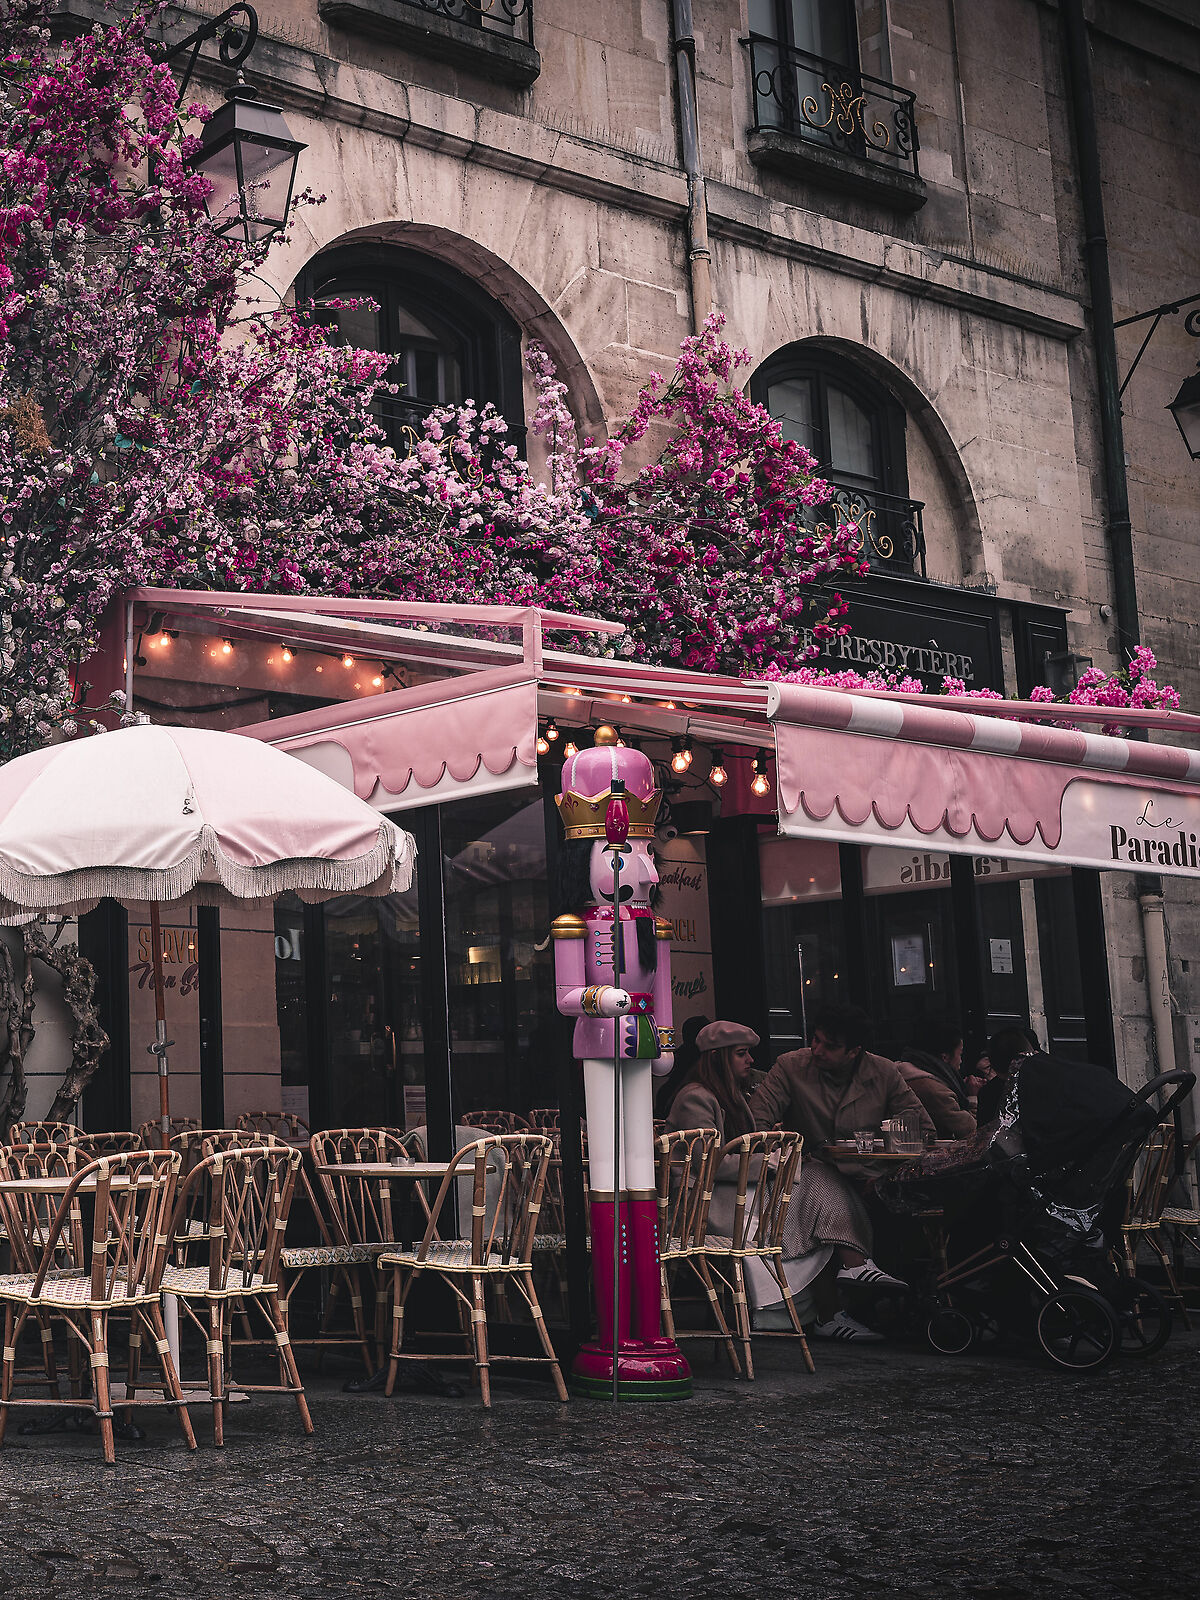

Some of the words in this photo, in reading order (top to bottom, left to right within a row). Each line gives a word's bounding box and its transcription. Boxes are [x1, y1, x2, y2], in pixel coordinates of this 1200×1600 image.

[821, 634, 974, 681] PRESBYTÈRE
[1136, 799, 1184, 829] Le
[1109, 825, 1200, 868] Paradi
[659, 867, 702, 891] eakfast
[670, 919, 697, 942] NCH
[671, 971, 707, 999] inner
